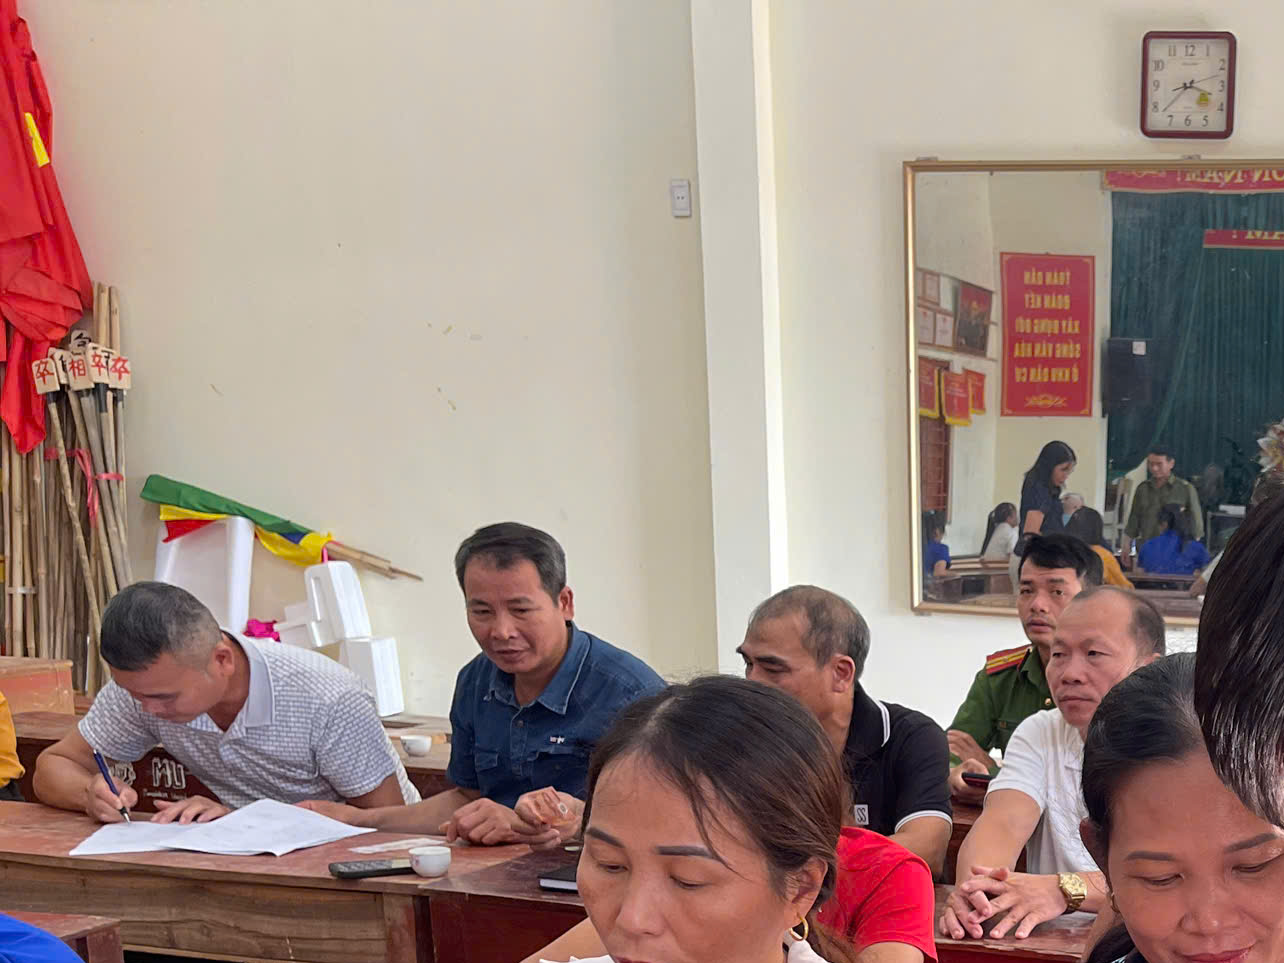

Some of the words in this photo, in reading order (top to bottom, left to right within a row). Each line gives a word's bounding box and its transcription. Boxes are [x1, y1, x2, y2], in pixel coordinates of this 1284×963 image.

[1185, 44, 1196, 57] 12
[1219, 58, 1226, 71] 2
[1153, 80, 1160, 92] 9
[1219, 80, 1225, 92] 3
[1152, 101, 1159, 113] 8
[1168, 114, 1174, 127] 7
[1184, 114, 1192, 127] 6
[1202, 114, 1209, 127] 5
